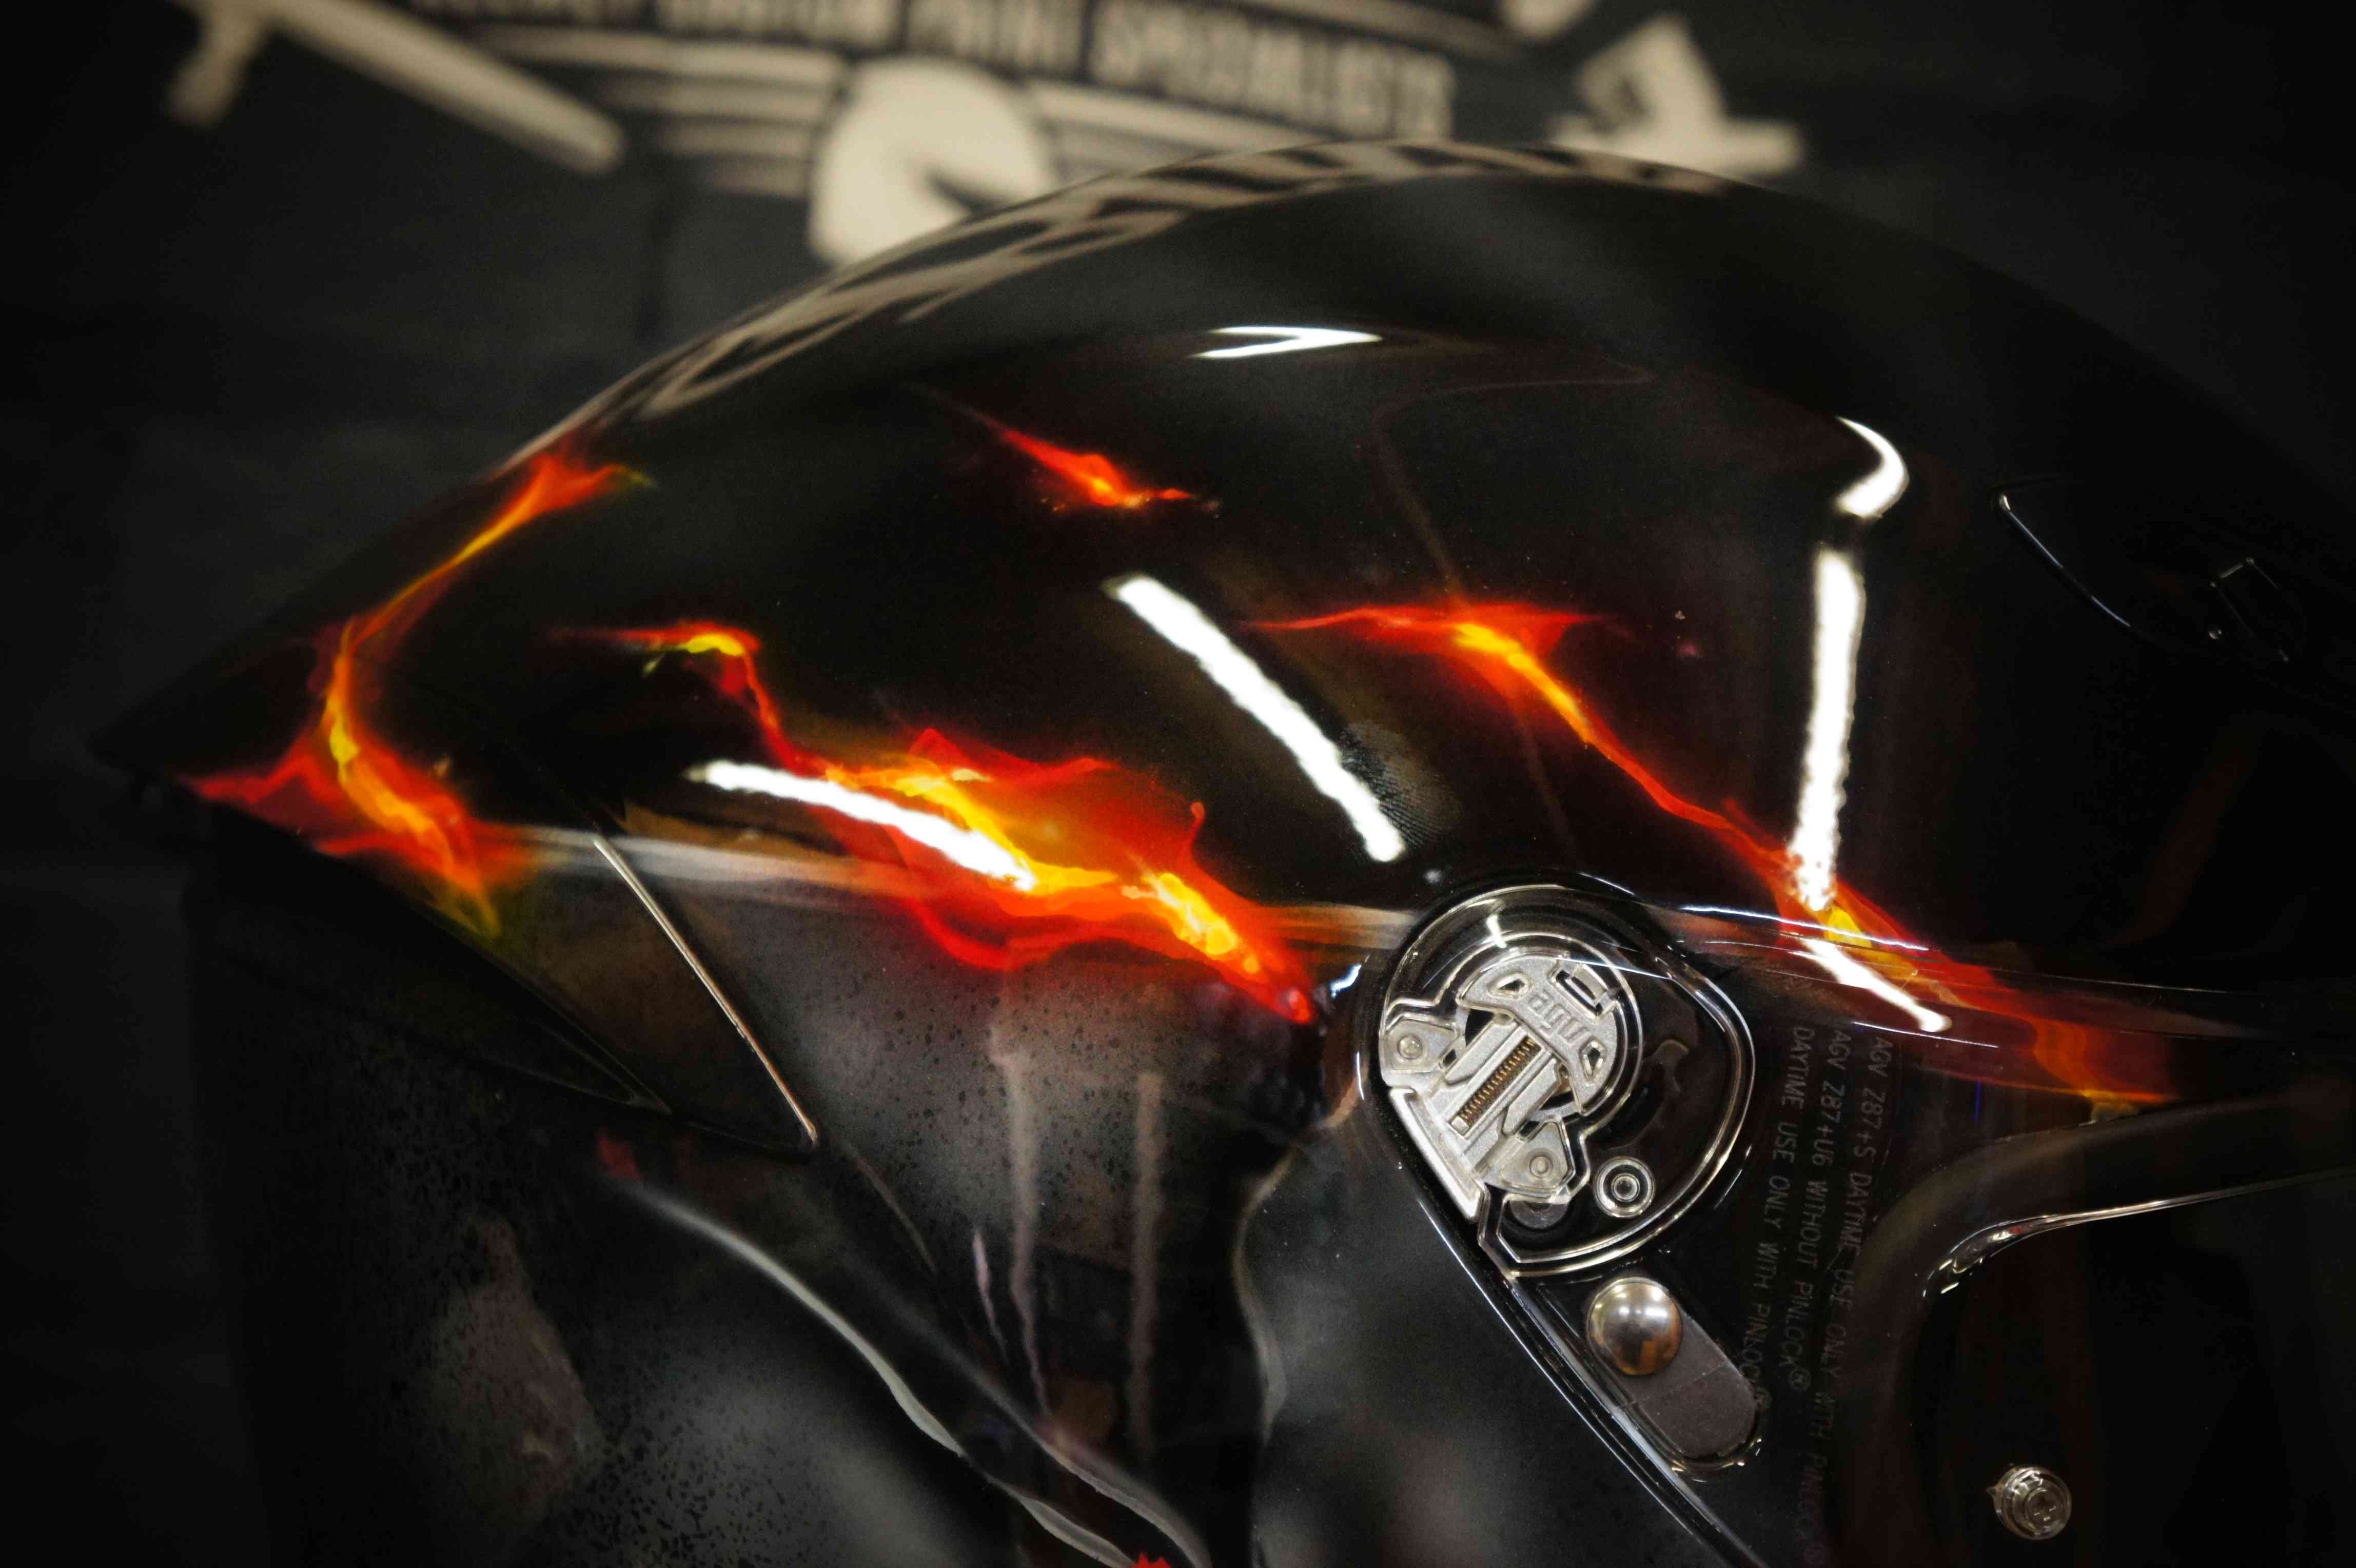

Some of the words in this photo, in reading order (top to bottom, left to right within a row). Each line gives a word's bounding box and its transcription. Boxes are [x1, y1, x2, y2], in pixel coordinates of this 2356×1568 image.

[1781, 1026, 1815, 1109] DAYTIME
[1827, 1030, 1852, 1070] AGV
[1867, 1036, 1894, 1076] AGV
[1772, 1121, 1798, 1164] USE
[1812, 1080, 1845, 1166] Z87+U6
[1853, 1087, 1886, 1159] Z87+S
[1763, 1175, 1791, 1230] ONLY
[1796, 1180, 1829, 1269] WITHOUT
[1838, 1171, 1872, 1256] DAYTIME
[1752, 1241, 1780, 1289] WITH
[1829, 1268, 1856, 1311] USE
[1819, 1322, 1847, 1379] ONLY
[1809, 1391, 1836, 1440] WITH
